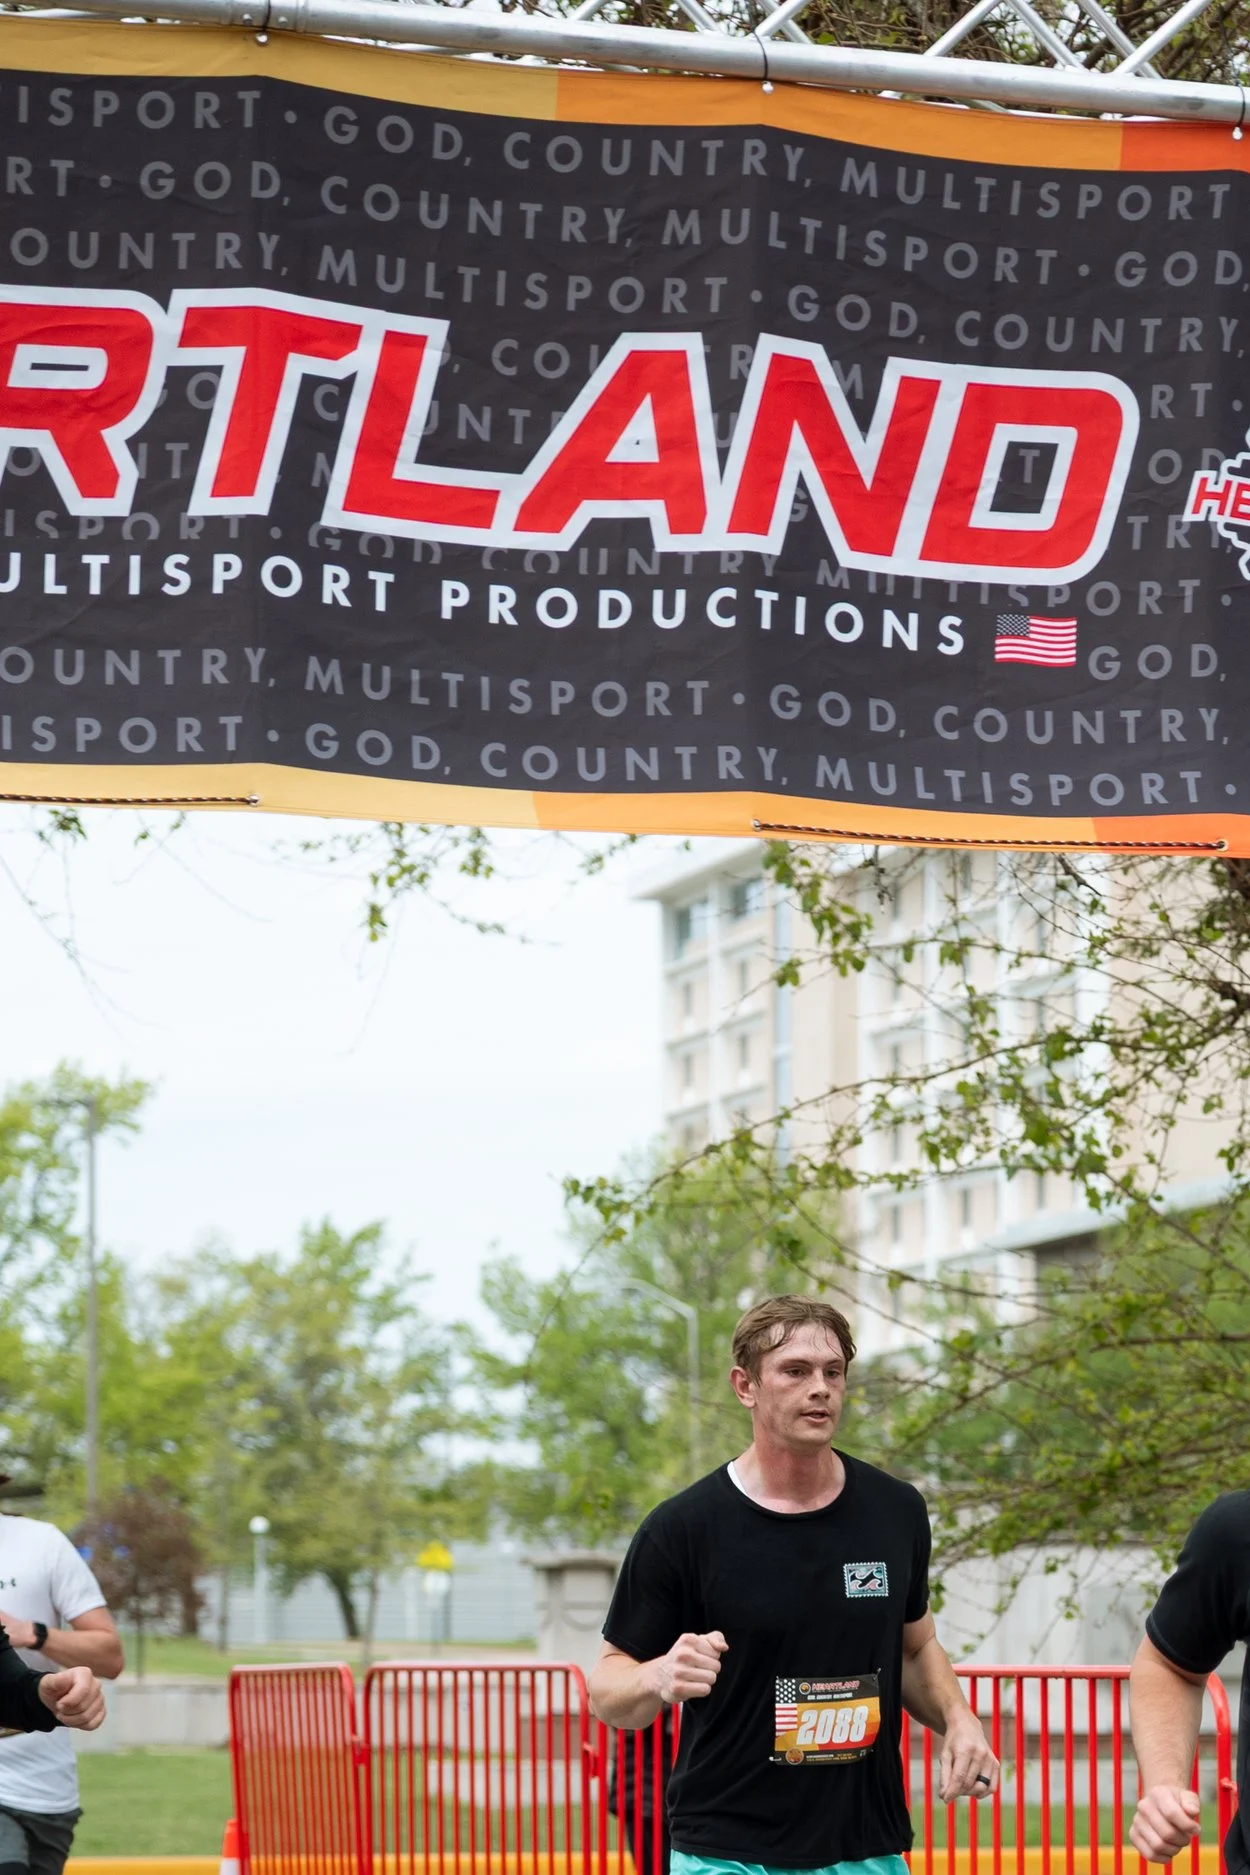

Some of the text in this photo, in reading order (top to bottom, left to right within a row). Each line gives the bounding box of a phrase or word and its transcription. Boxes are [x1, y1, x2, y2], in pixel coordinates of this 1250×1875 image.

[18, 85, 262, 130] ISPORT
[323, 105, 472, 167] GOD,
[503, 131, 812, 188] COUNTRY,
[839, 157, 1231, 222] MULTISPORT
[138, 160, 290, 207] GOD,
[320, 175, 633, 248] COUNTRY,
[661, 207, 1058, 285] MULTISPORT
[1114, 249, 1250, 292] GOD,
[9, 227, 288, 276] OUNTRY,
[316, 244, 729, 315] MULTISPORT
[787, 284, 926, 345] GOD,
[954, 309, 1245, 359] COUNTRY,
[0, 285, 1140, 585] RTLAND
[0, 550, 966, 658] ULTISPORT PRODUCTIONS
[480, 547, 778, 578] COUNTRY
[304, 655, 710, 719] MULTISPORT
[769, 683, 906, 739] GOD,
[933, 704, 1229, 746] COUNTRY,
[1087, 642, 1227, 682] GOD,
[1, 714, 244, 754] ISPORT
[304, 722, 451, 776] GOD,
[479, 741, 788, 786] COUNTRY,
[815, 754, 1203, 807] MULTISPORT
[796, 1706, 868, 1745] 2088
